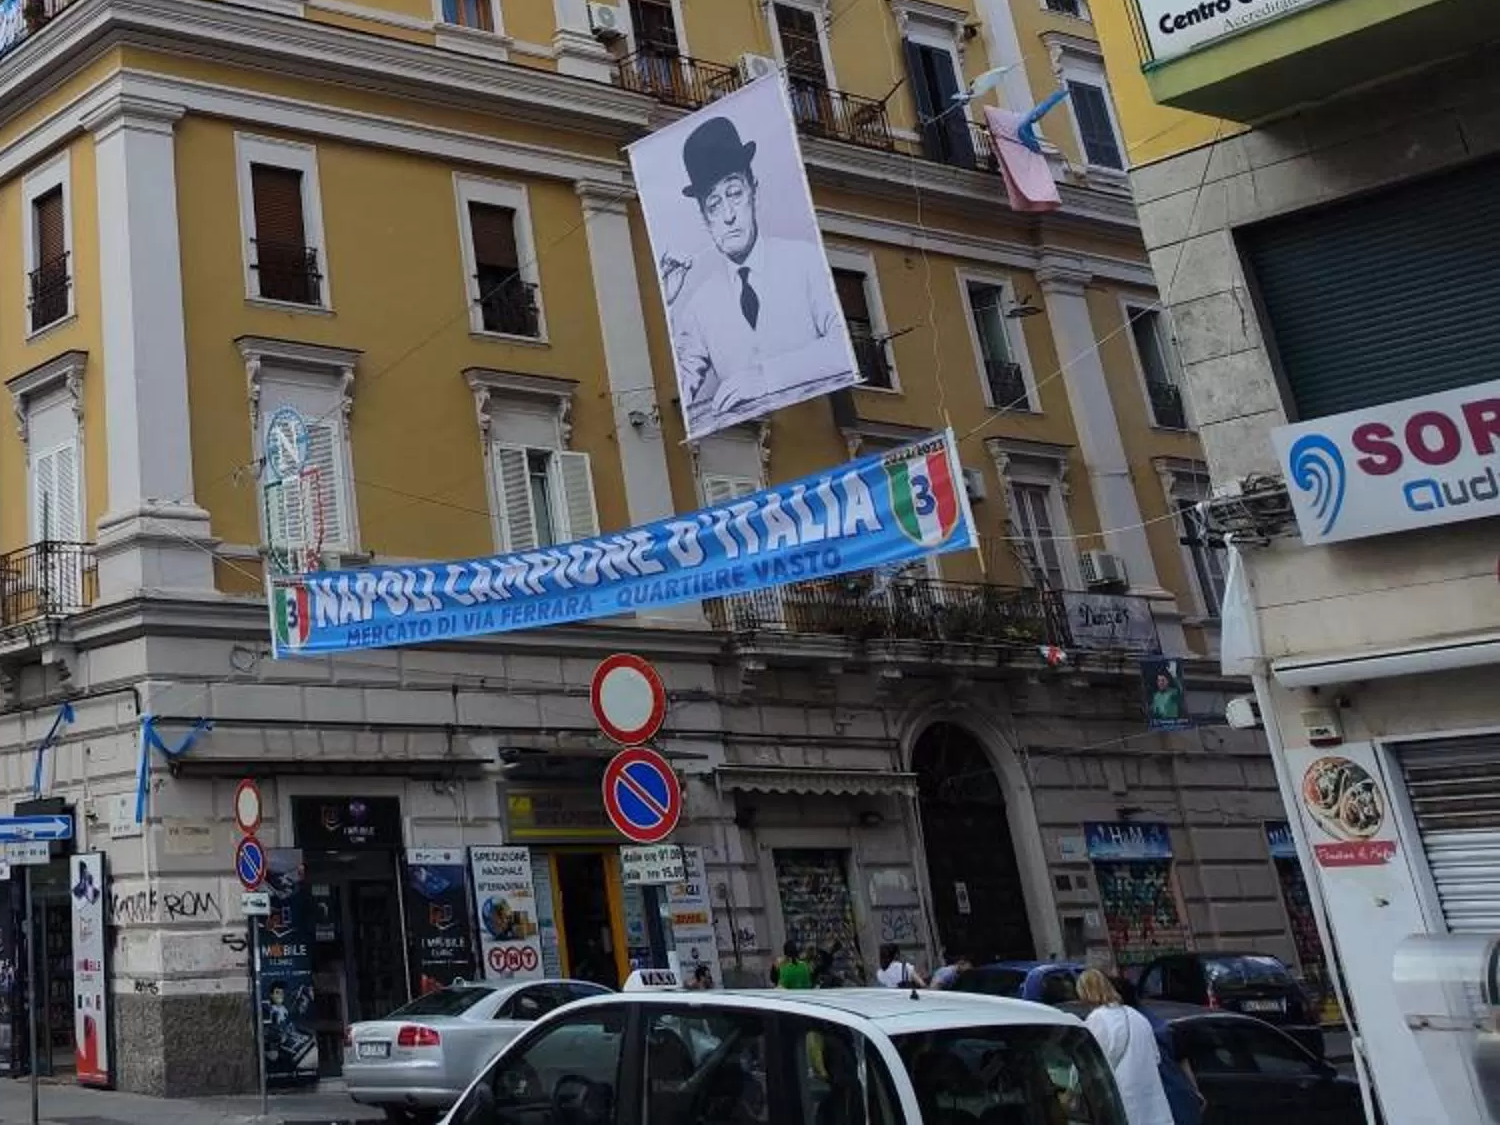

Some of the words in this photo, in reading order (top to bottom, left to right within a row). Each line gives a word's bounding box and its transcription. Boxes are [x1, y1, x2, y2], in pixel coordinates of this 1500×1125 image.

[1352, 398, 1500, 476] SOR
[910, 475, 936, 517] 3
[311, 569, 444, 629] NAPOLI
[443, 530, 667, 607] CAMPIONE
[666, 471, 884, 569] D'ITALIA
[287, 598, 299, 629] 3
[345, 619, 433, 648] MERCATO
[437, 615, 459, 635] DI
[463, 609, 495, 633] VIA
[500, 595, 593, 627] FERRARA
[616, 565, 746, 608] QUARTIERE
[751, 546, 843, 588] VASTO
[490, 949, 537, 969] TNT
